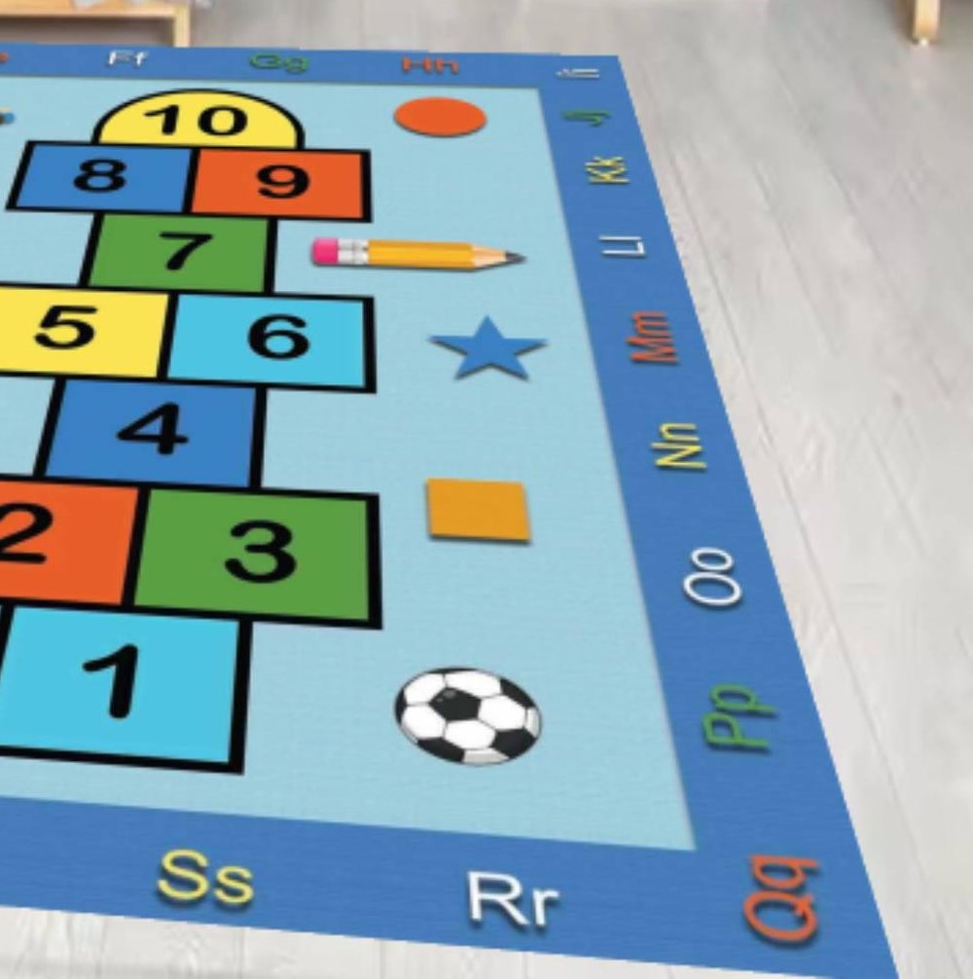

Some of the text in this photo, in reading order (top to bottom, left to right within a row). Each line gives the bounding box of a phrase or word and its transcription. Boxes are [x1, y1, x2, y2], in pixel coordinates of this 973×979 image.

[108, 49, 148, 66] Ff
[249, 53, 310, 73] Gg
[401, 56, 460, 74] Hh
[143, 103, 249, 137] 10
[74, 159, 125, 192] 8
[258, 166, 308, 198] 9
[584, 155, 631, 184] Kk
[160, 232, 212, 270] 7
[36, 306, 96, 349] 5
[249, 315, 308, 359] 6
[626, 310, 678, 362] Mm
[117, 403, 187, 454] 4
[650, 422, 707, 469] Nn
[225, 520, 296, 583] 3
[682, 546, 743, 606] Oo
[84, 645, 137, 718] 1
[701, 683, 777, 749] Pp
[155, 847, 255, 907] Ss
[467, 869, 561, 927] Rr
[743, 854, 819, 941] Qq
